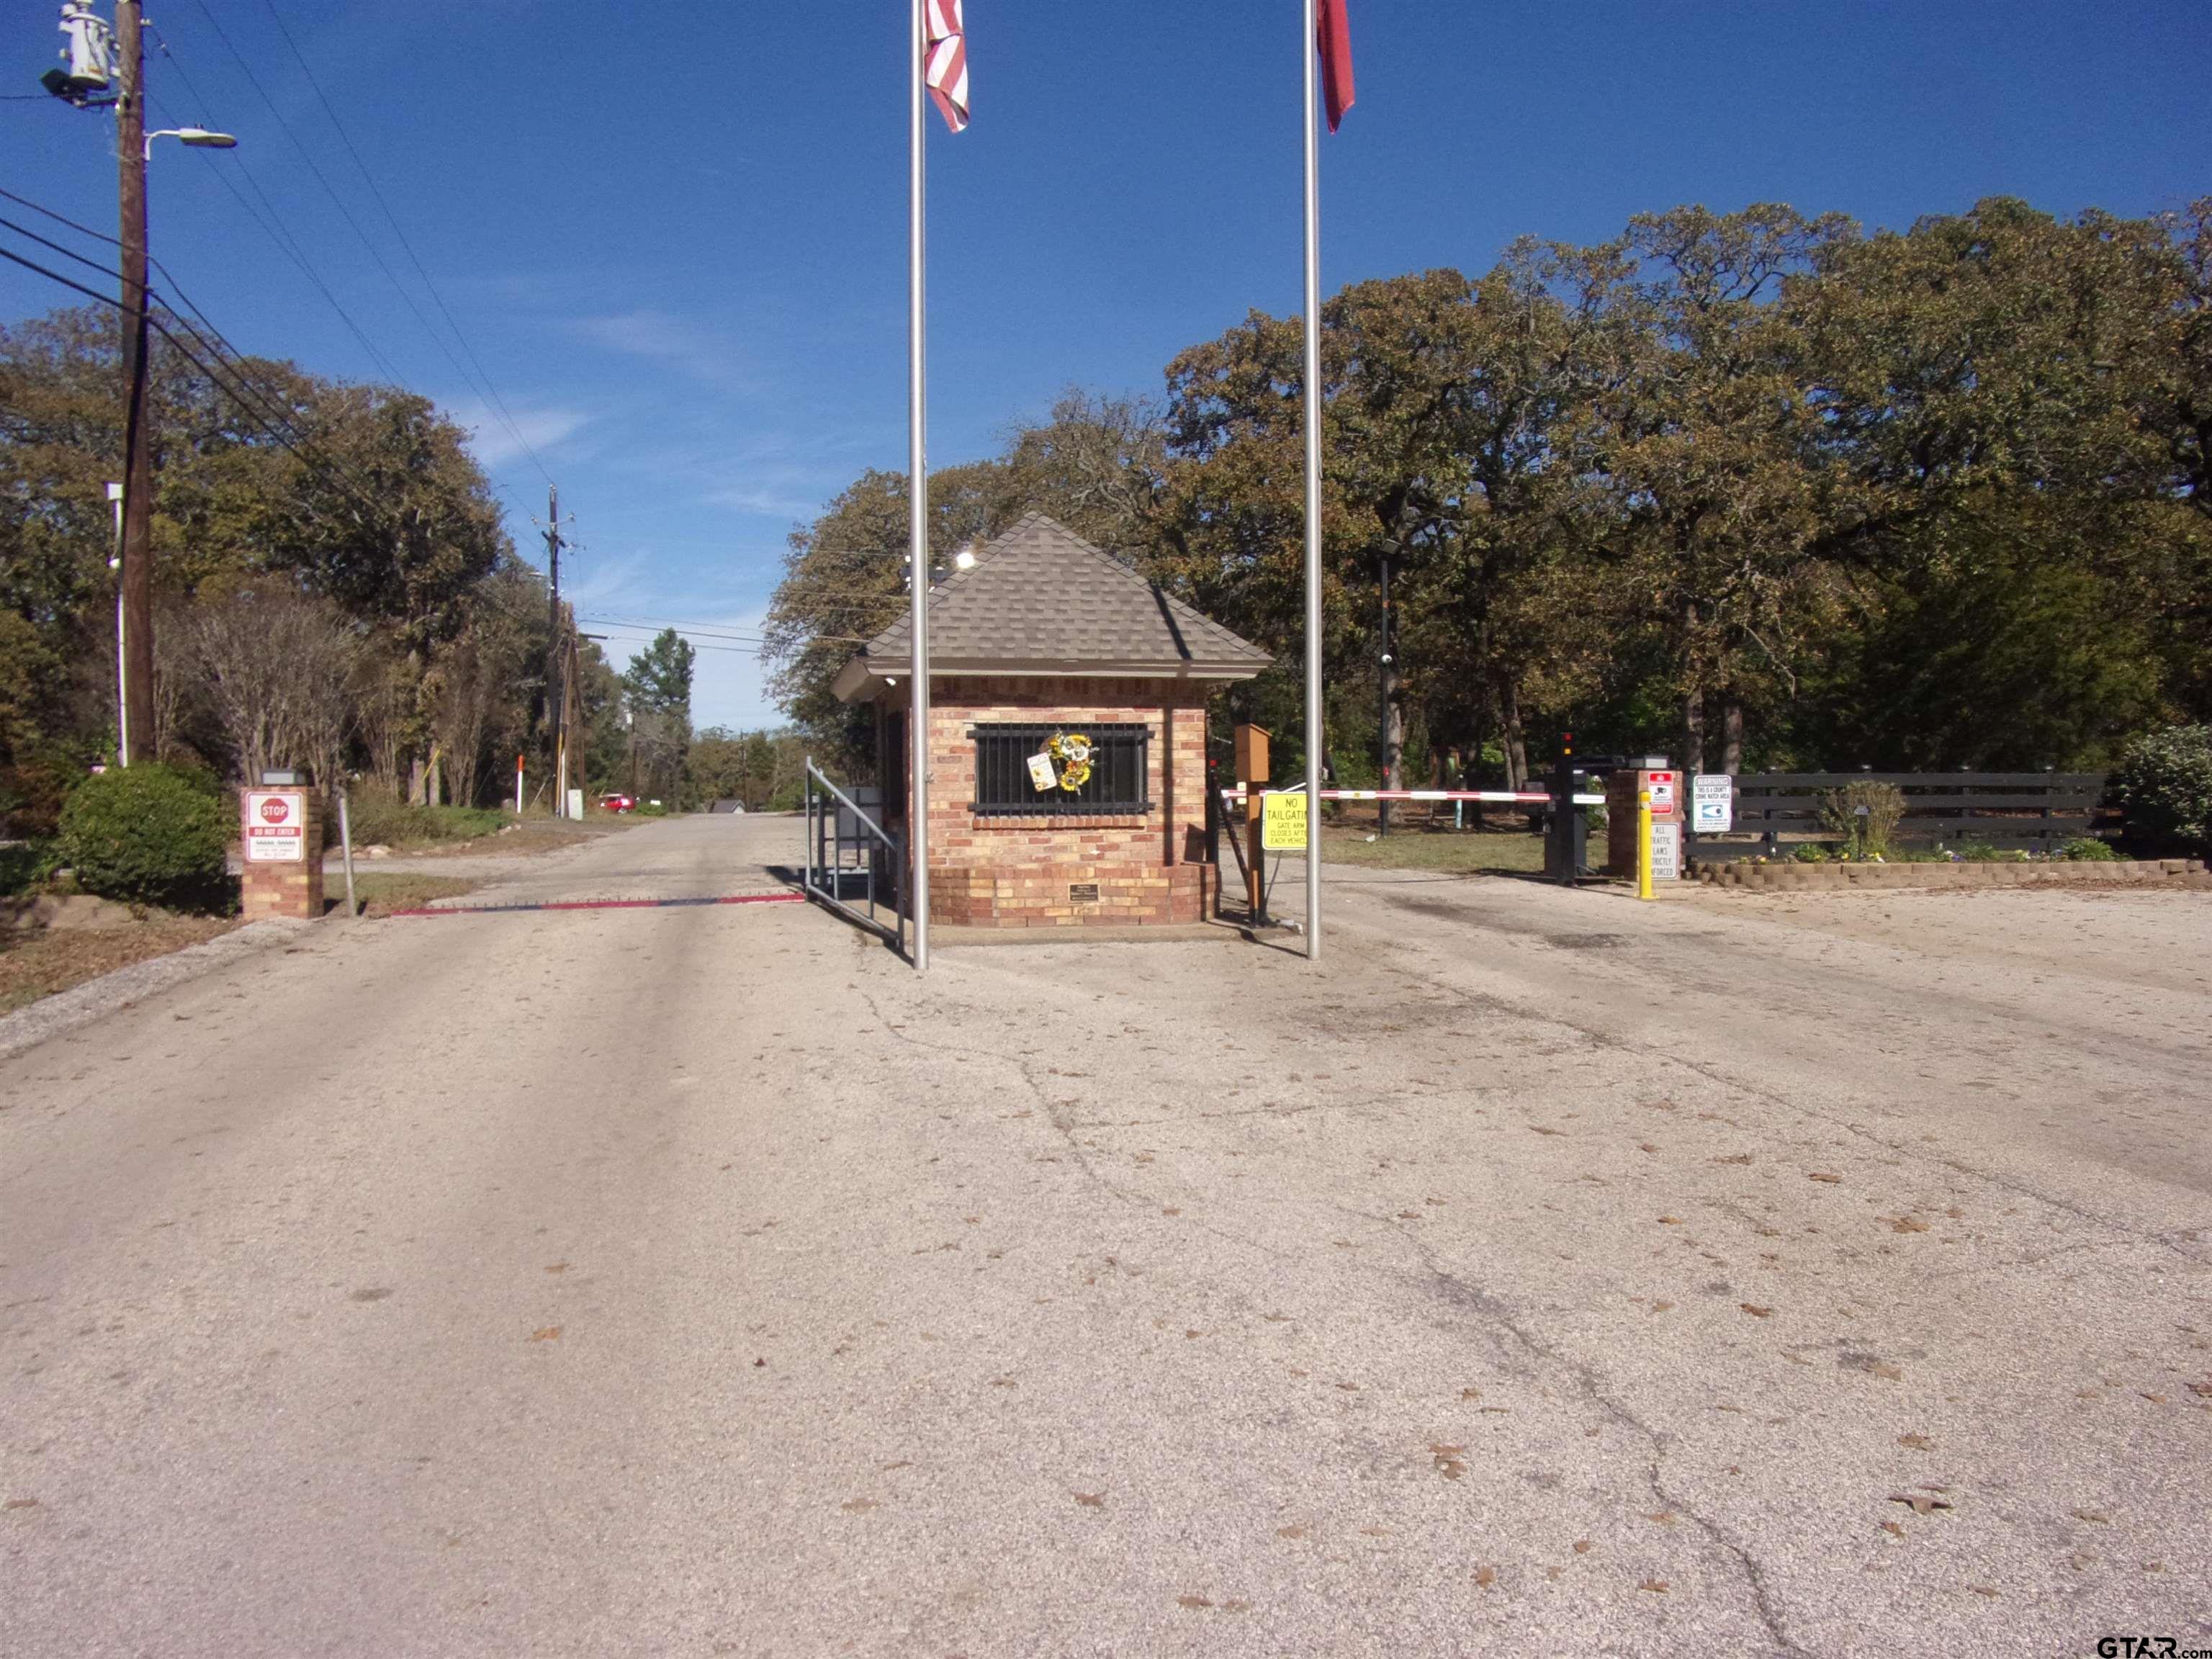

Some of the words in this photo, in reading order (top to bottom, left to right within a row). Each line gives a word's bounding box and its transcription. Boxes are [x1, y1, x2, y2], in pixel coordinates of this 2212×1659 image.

[1285, 798, 1298, 808] NO
[262, 805, 287, 817] STOP
[1655, 826, 1665, 835] ALL
[1650, 836, 1671, 845] RAFFIC
[1653, 847, 1667, 855] LAWS
[1650, 868, 1673, 876] NFORCED
